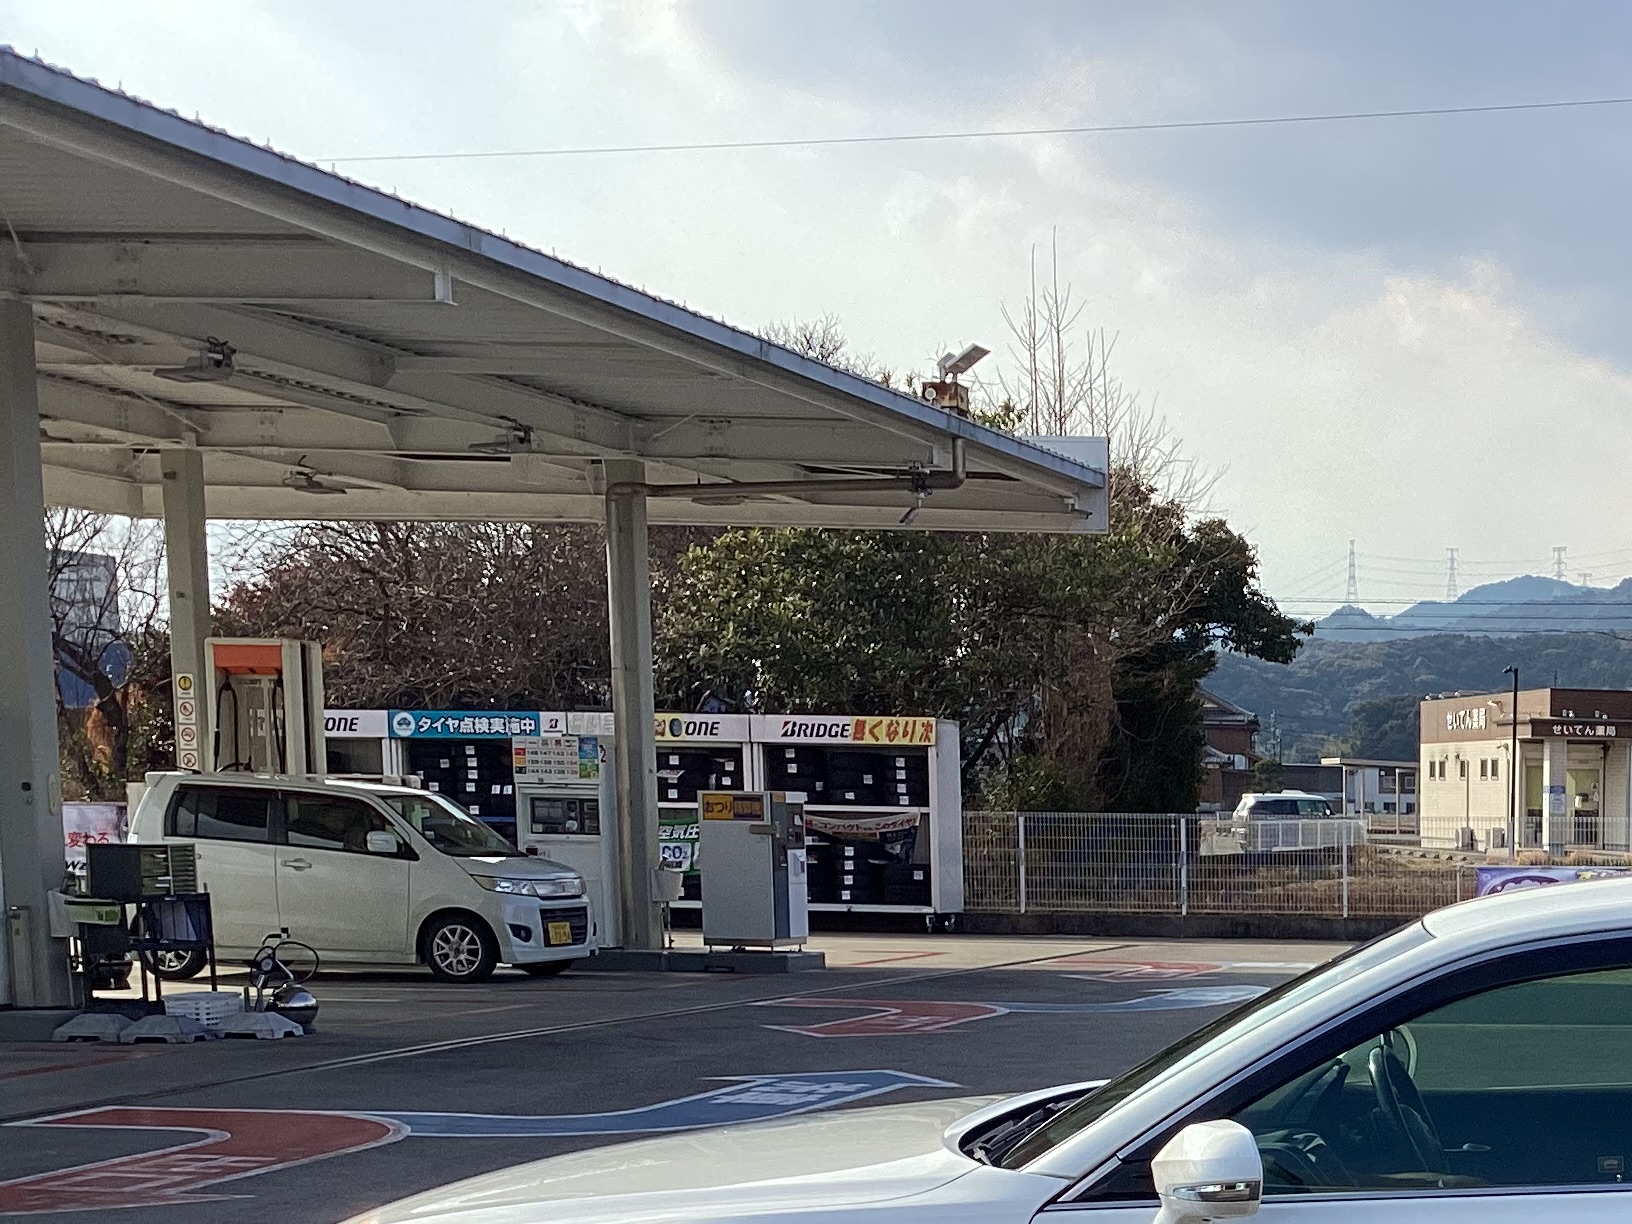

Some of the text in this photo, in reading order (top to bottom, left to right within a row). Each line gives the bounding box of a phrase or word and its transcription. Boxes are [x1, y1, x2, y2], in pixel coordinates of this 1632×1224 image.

[1552, 724, 1617, 737] せいてん薬局
